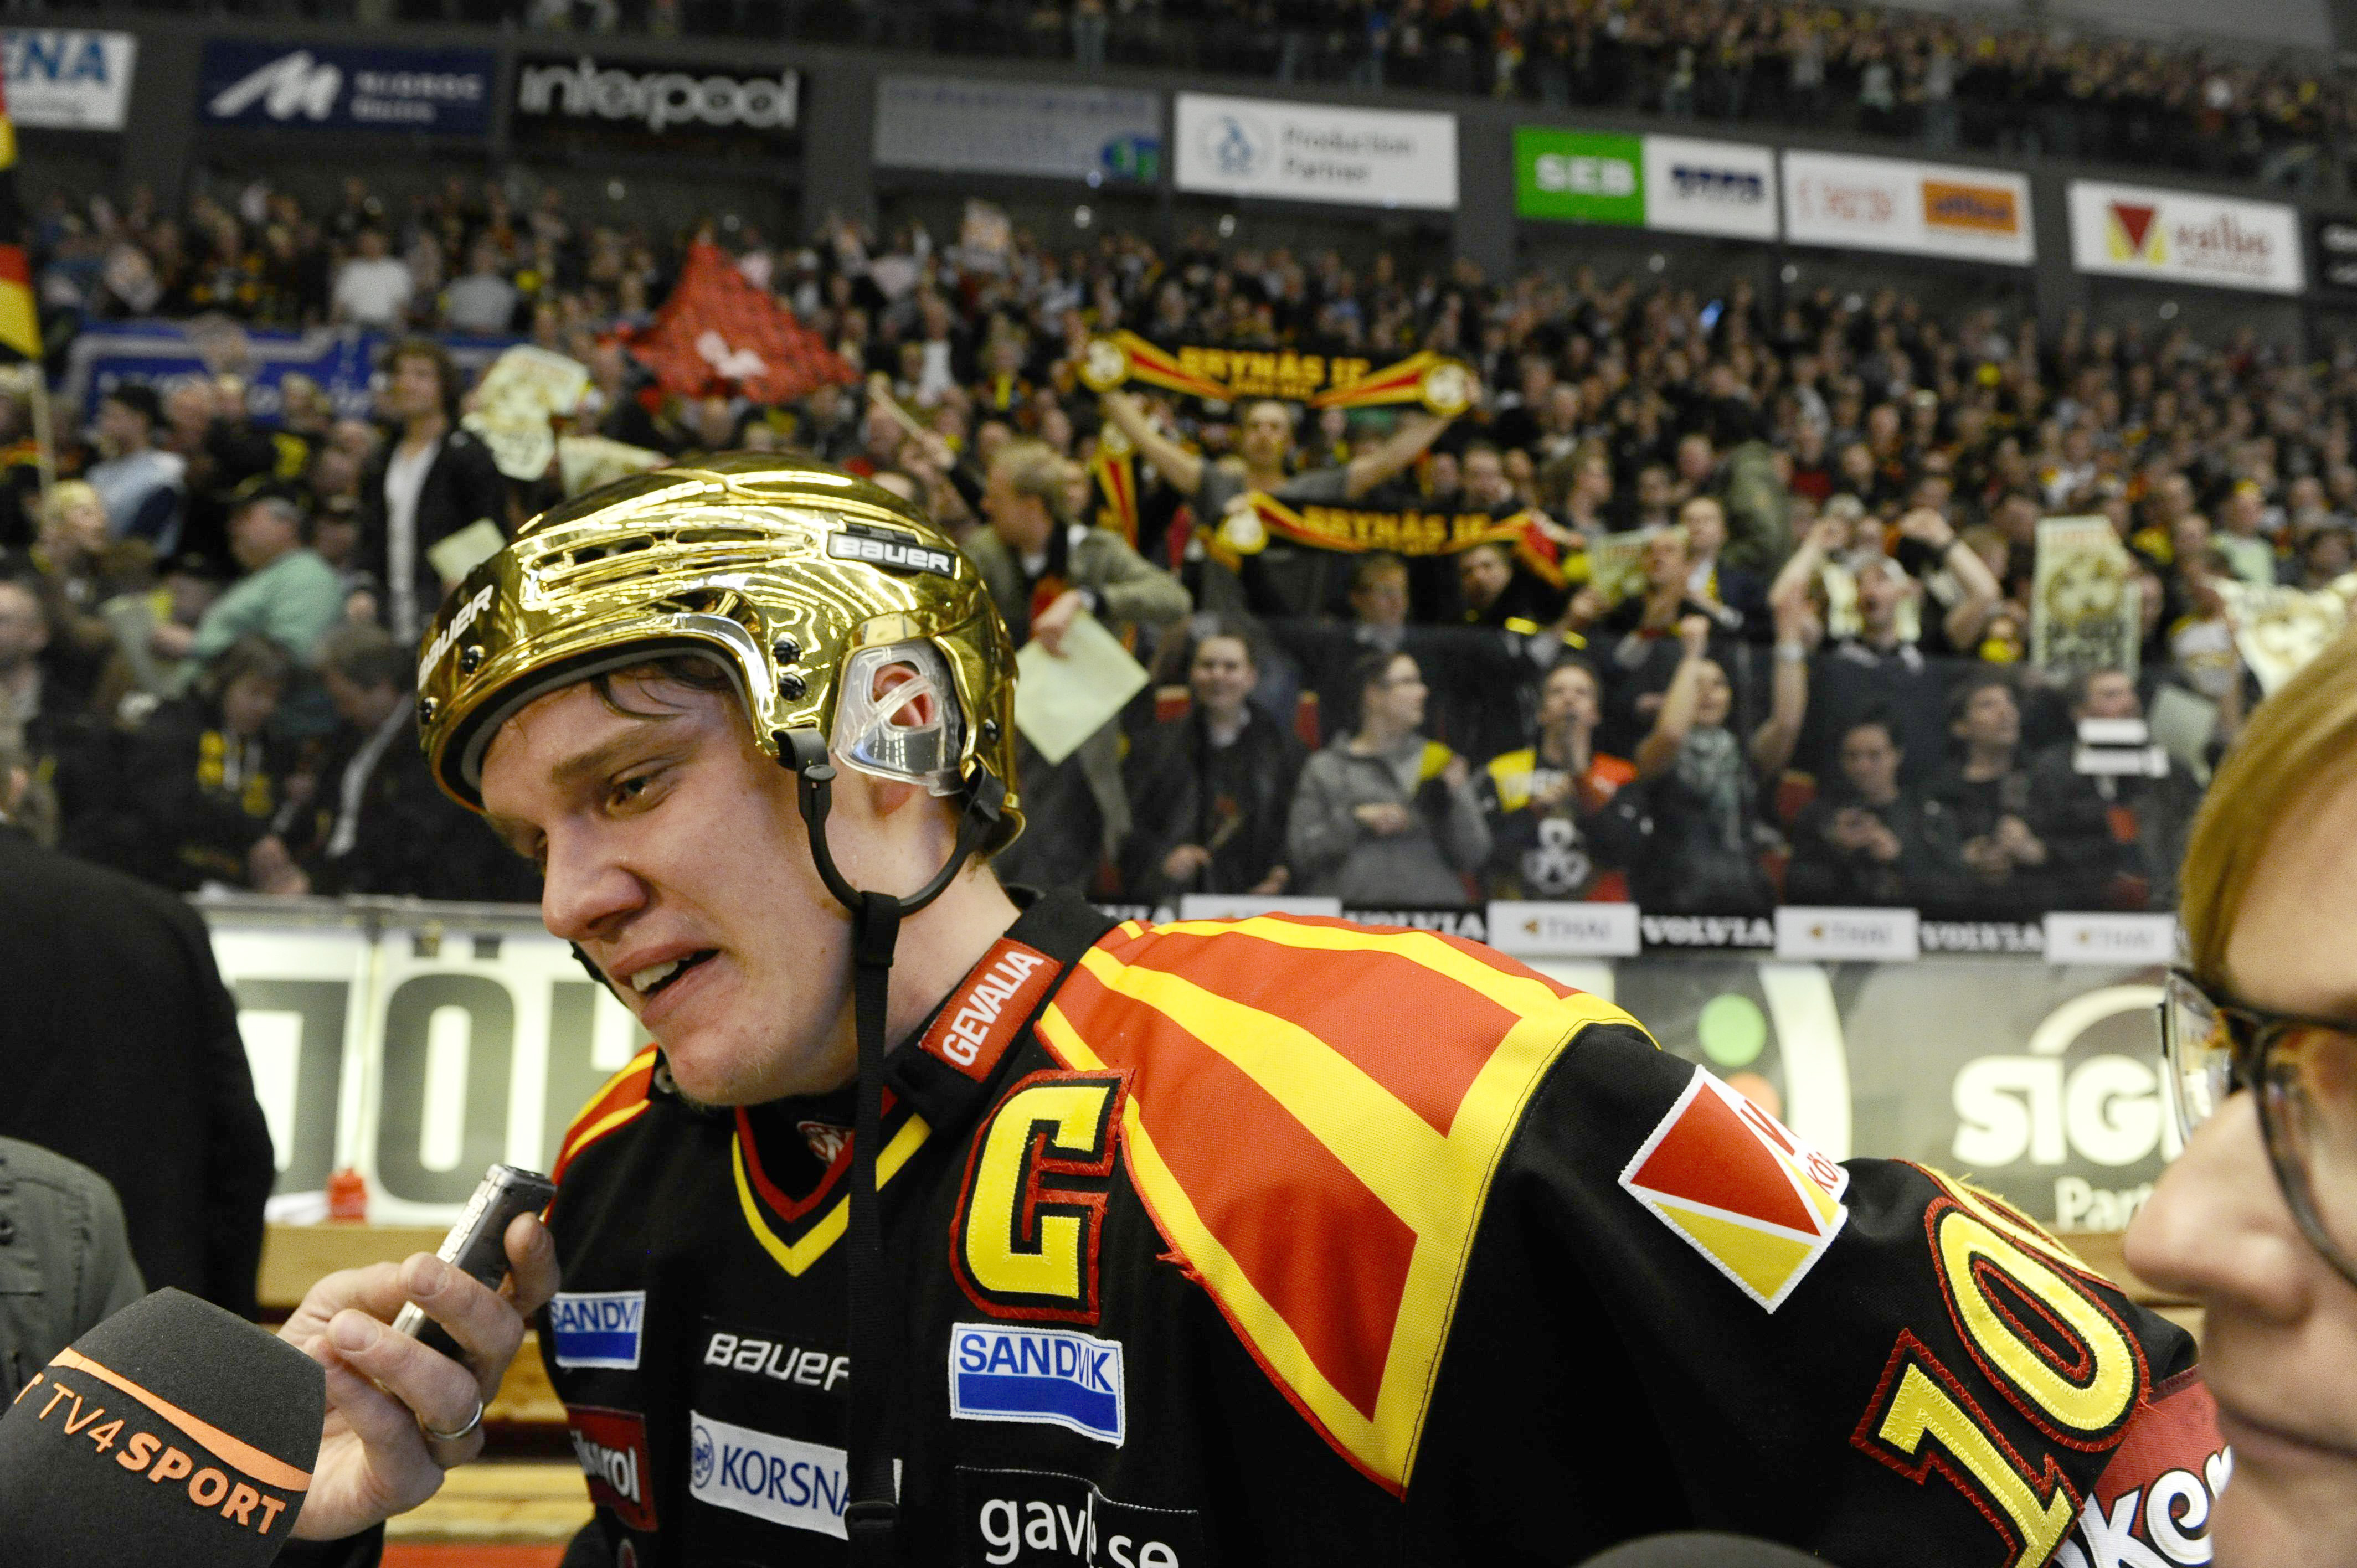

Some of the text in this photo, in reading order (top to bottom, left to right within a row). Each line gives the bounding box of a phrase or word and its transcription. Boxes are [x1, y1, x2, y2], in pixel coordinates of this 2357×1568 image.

[519, 56, 799, 133] interpool
[1534, 152, 1634, 197] SEB
[943, 951, 1044, 1066] GEVALIA
[959, 1334, 1114, 1392] SANDVIK
